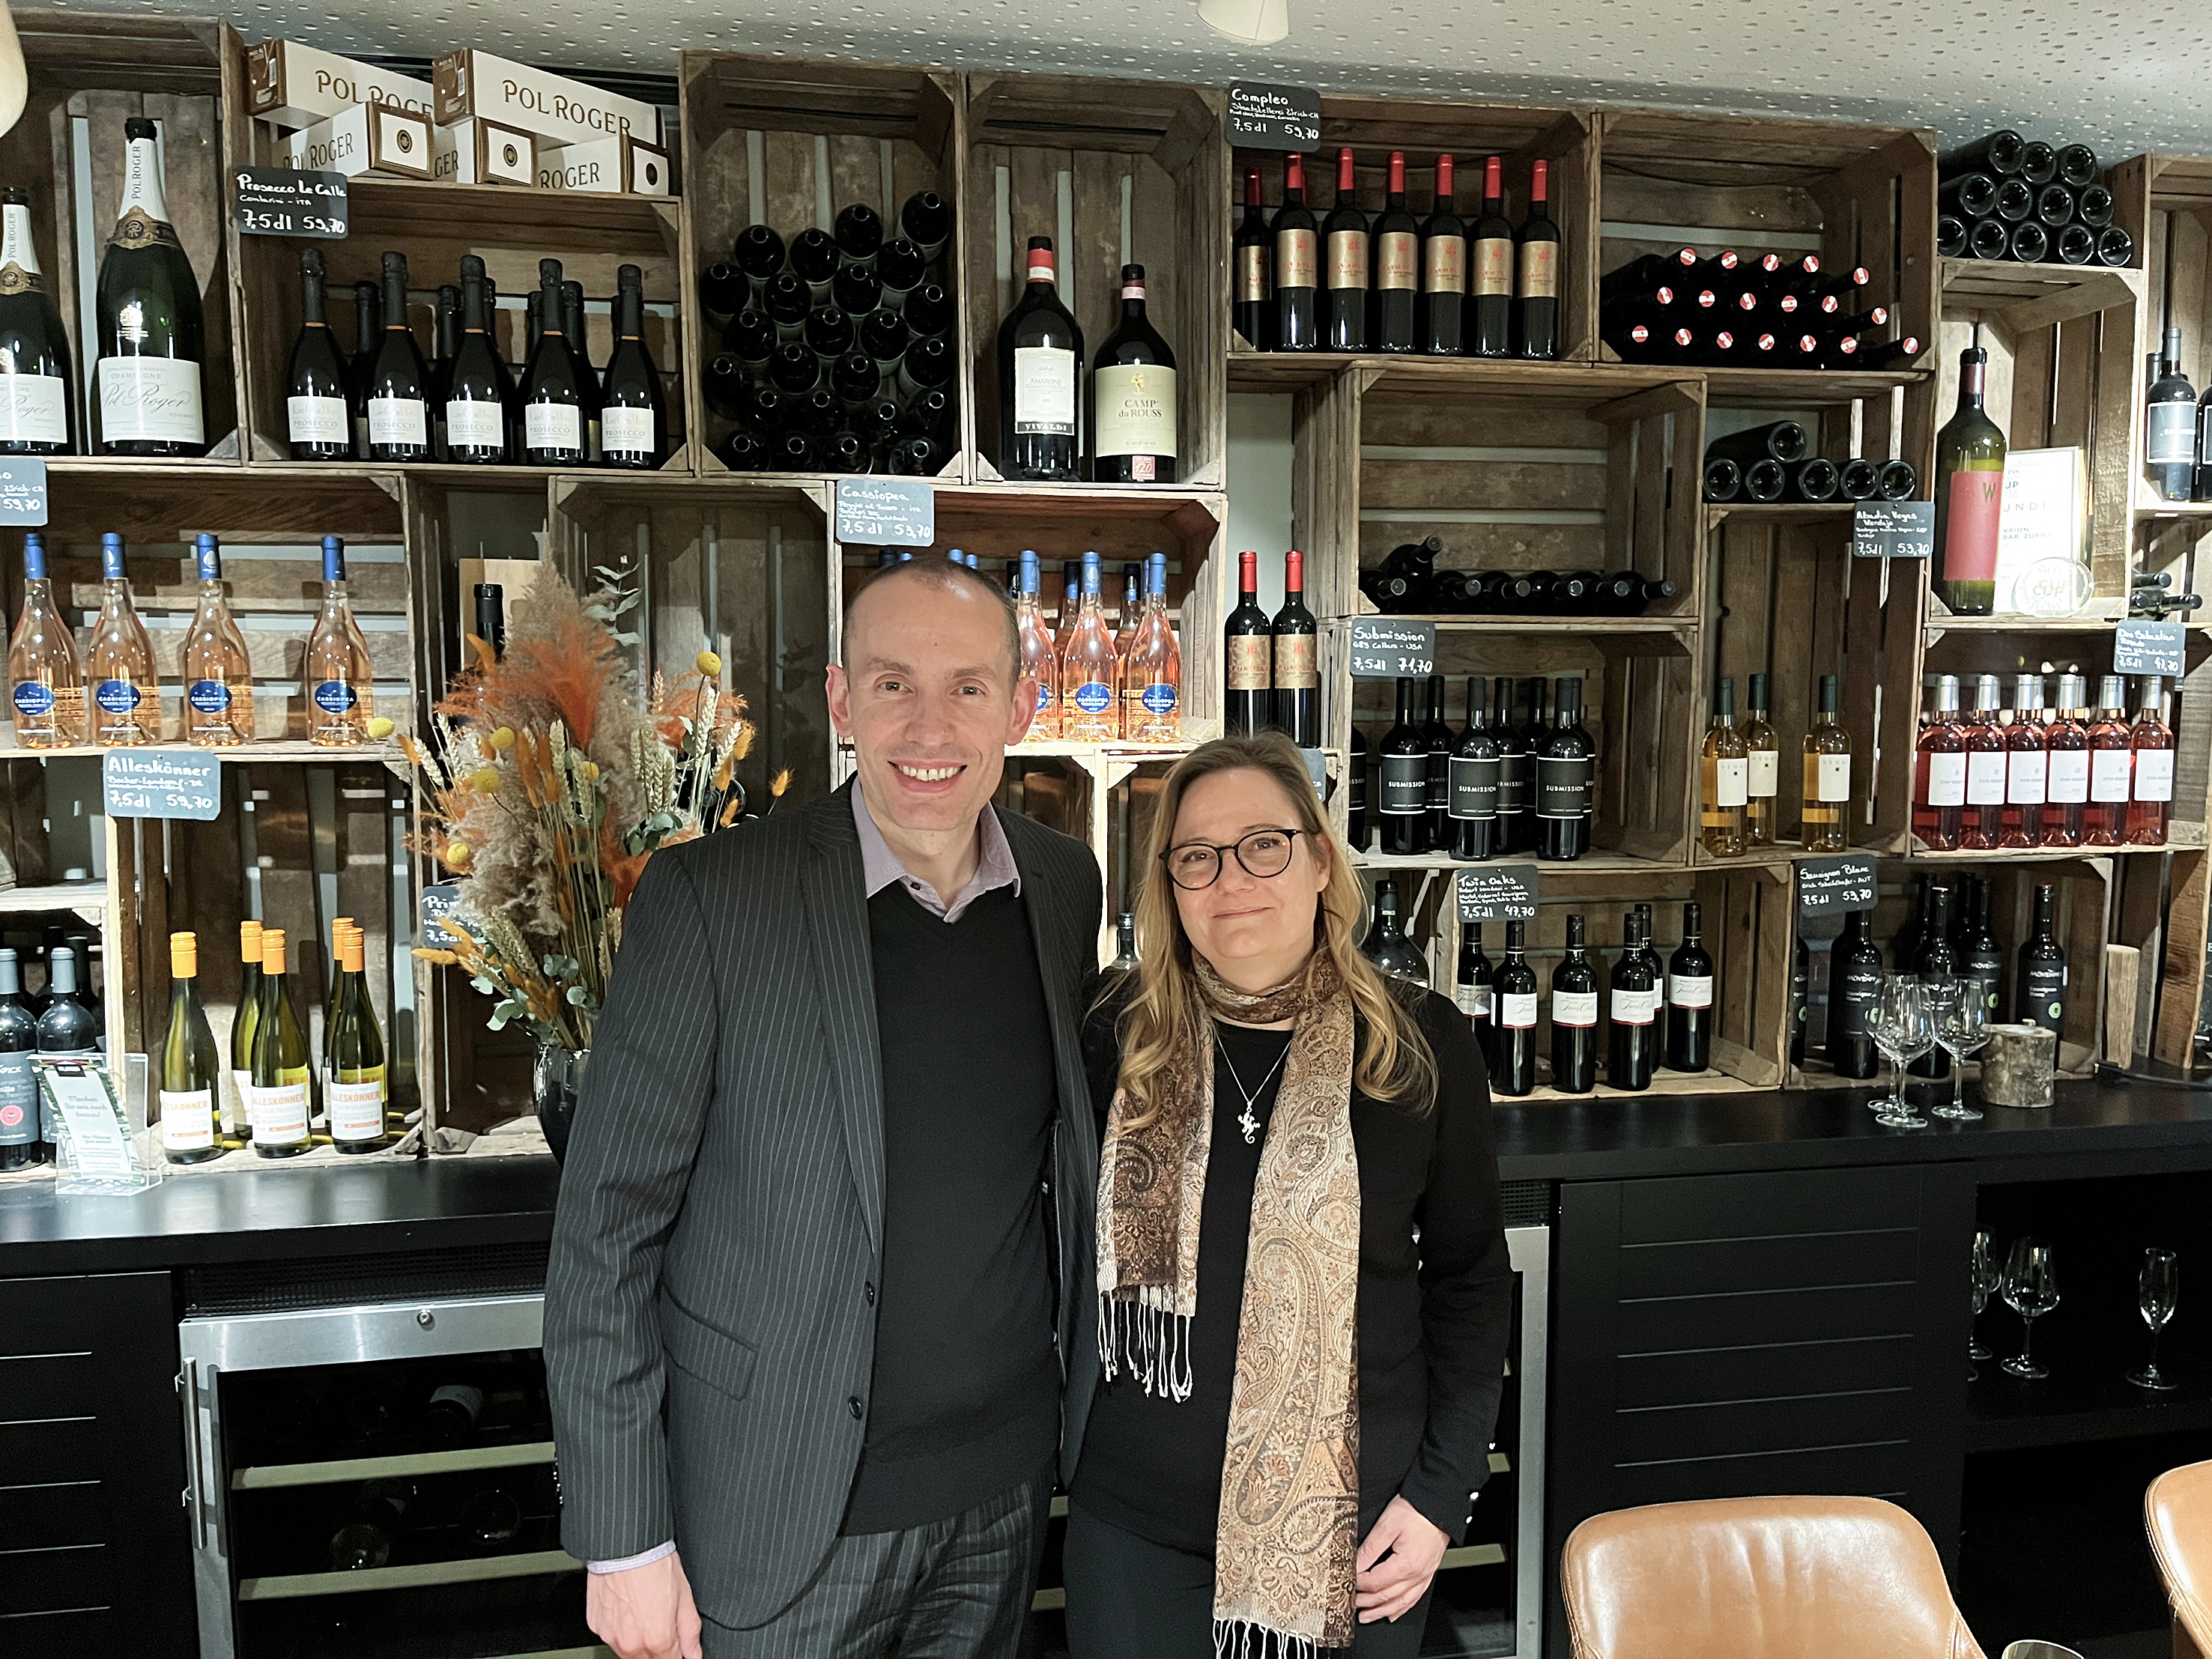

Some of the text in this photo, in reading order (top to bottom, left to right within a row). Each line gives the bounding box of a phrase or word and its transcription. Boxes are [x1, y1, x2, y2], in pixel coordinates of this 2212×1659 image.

[315, 70, 365, 103] POL
[369, 85, 433, 115] ROGE
[1231, 88, 1288, 107] Compleo
[502, 79, 631, 136] POL ROGER
[310, 133, 353, 169] ROGER
[132, 146, 140, 199] POL ROGER
[435, 151, 458, 178] GER
[237, 174, 295, 192] Prosecco
[298, 180, 313, 194] Le
[539, 163, 599, 189] ROGER
[1125, 399, 1157, 407] CAMP
[1131, 409, 1162, 417] ROUSS
[1025, 423, 1067, 431] VIVALDI
[1135, 463, 1152, 473] 120
[841, 485, 909, 503] Cassiopea
[1354, 625, 1425, 641] Submission
[1488, 875, 1516, 885] Oaks
